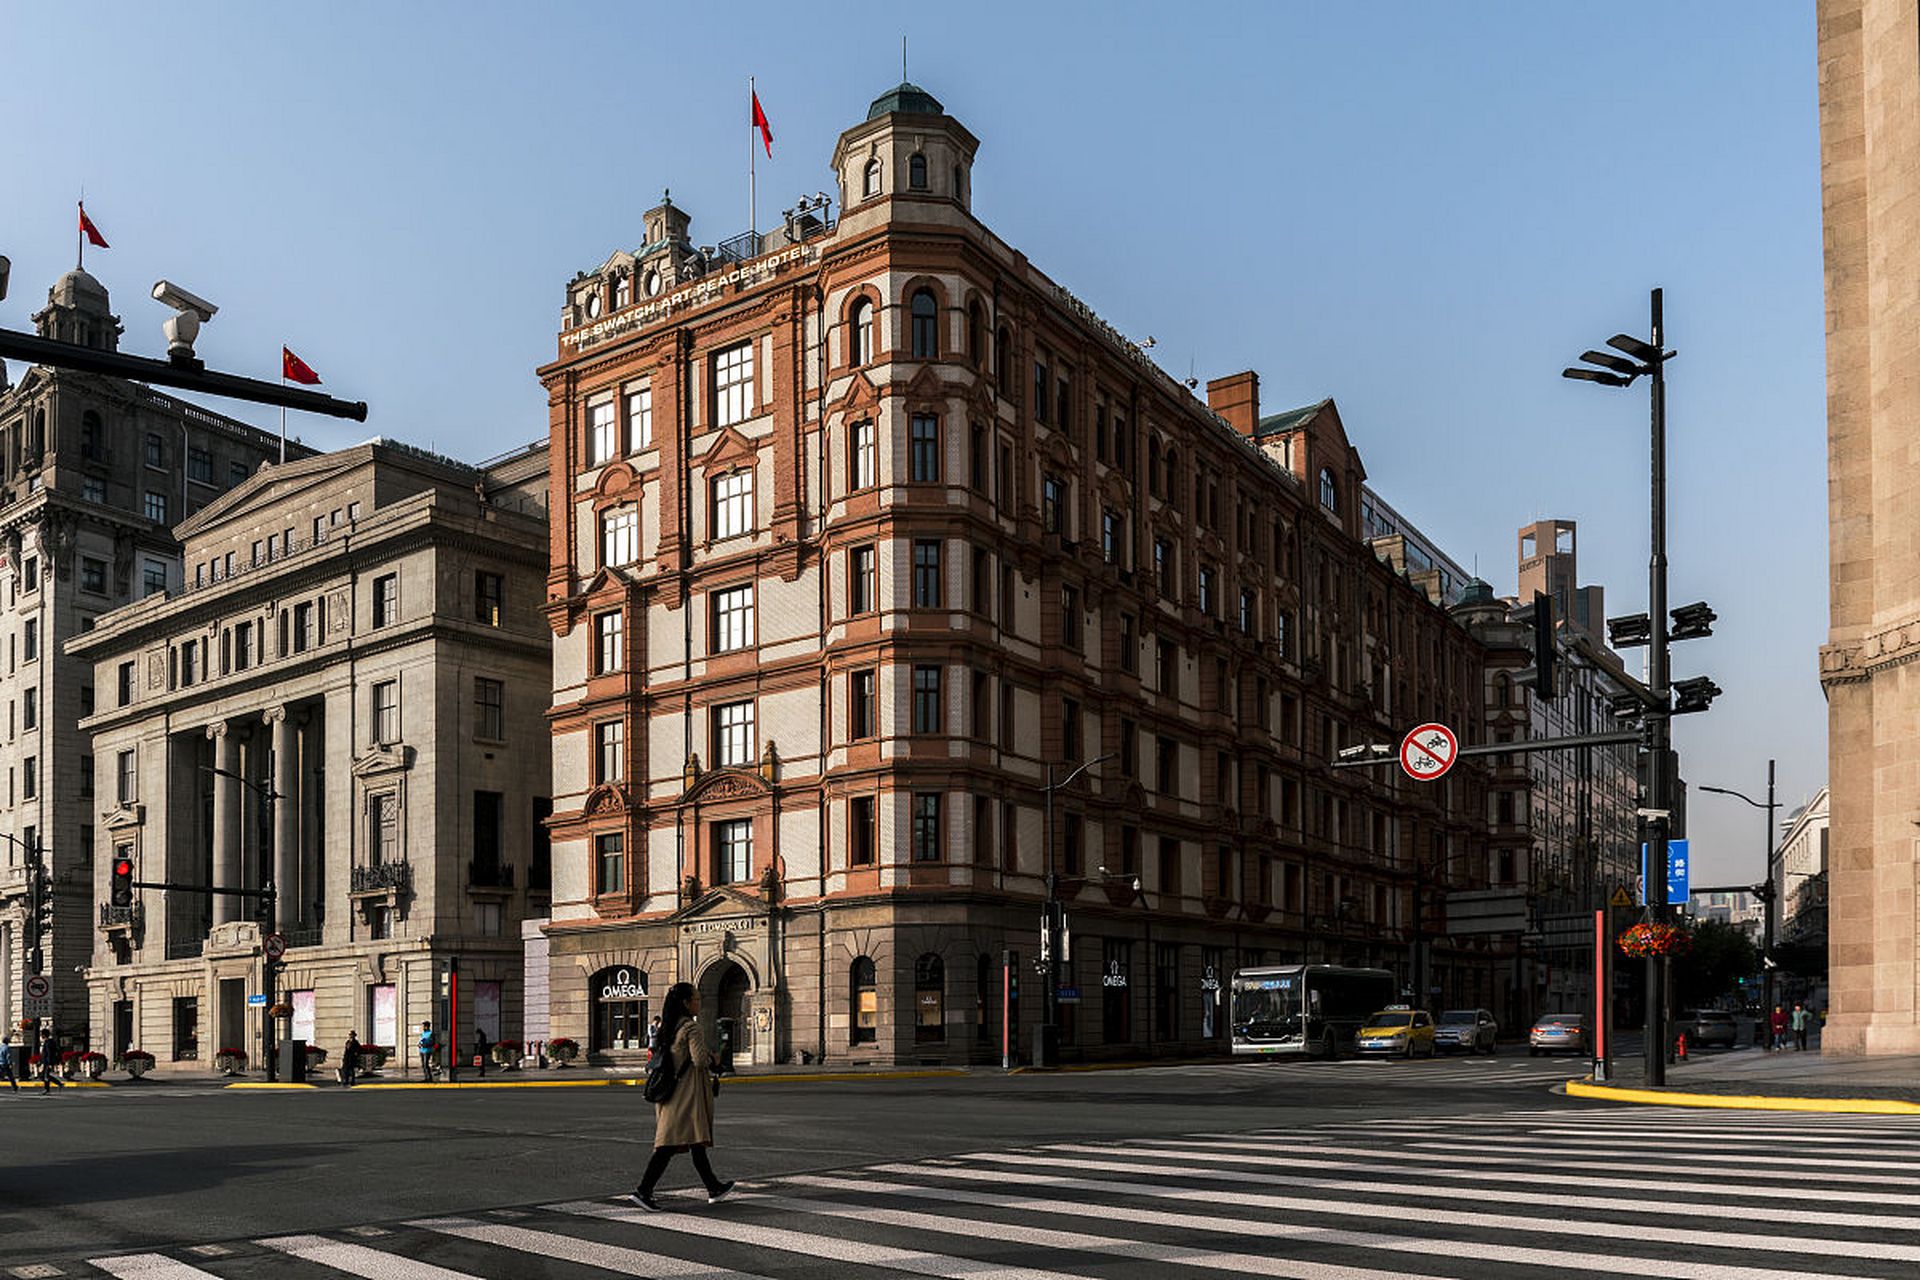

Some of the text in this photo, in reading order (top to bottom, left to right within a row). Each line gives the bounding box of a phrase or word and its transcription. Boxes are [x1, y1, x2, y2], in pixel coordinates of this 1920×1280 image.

[561, 244, 810, 346] THE SWATCH ART PEACE HOTEL
[602, 984, 648, 998] OMEGA
